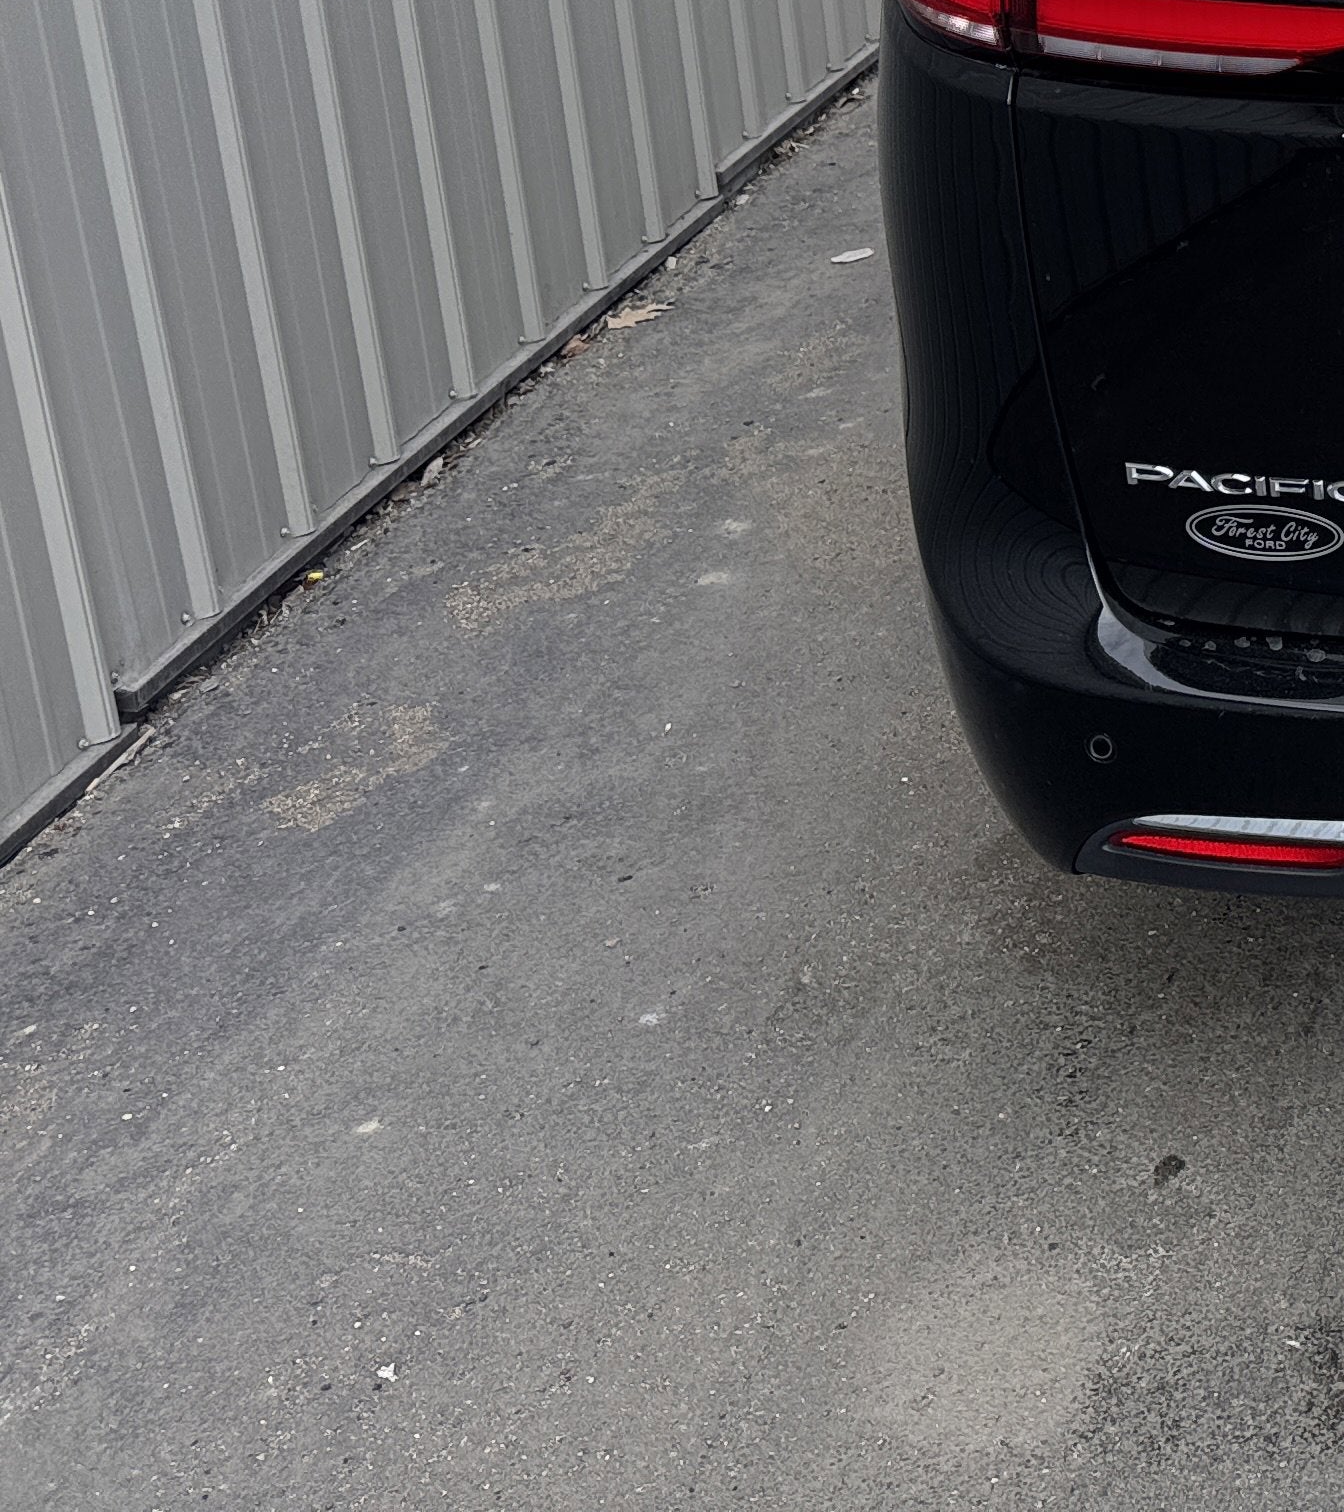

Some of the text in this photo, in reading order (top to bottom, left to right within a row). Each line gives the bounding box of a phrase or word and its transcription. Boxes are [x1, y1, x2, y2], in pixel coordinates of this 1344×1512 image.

[1211, 515, 1319, 550] Forest City
[1244, 538, 1287, 550] FORD
